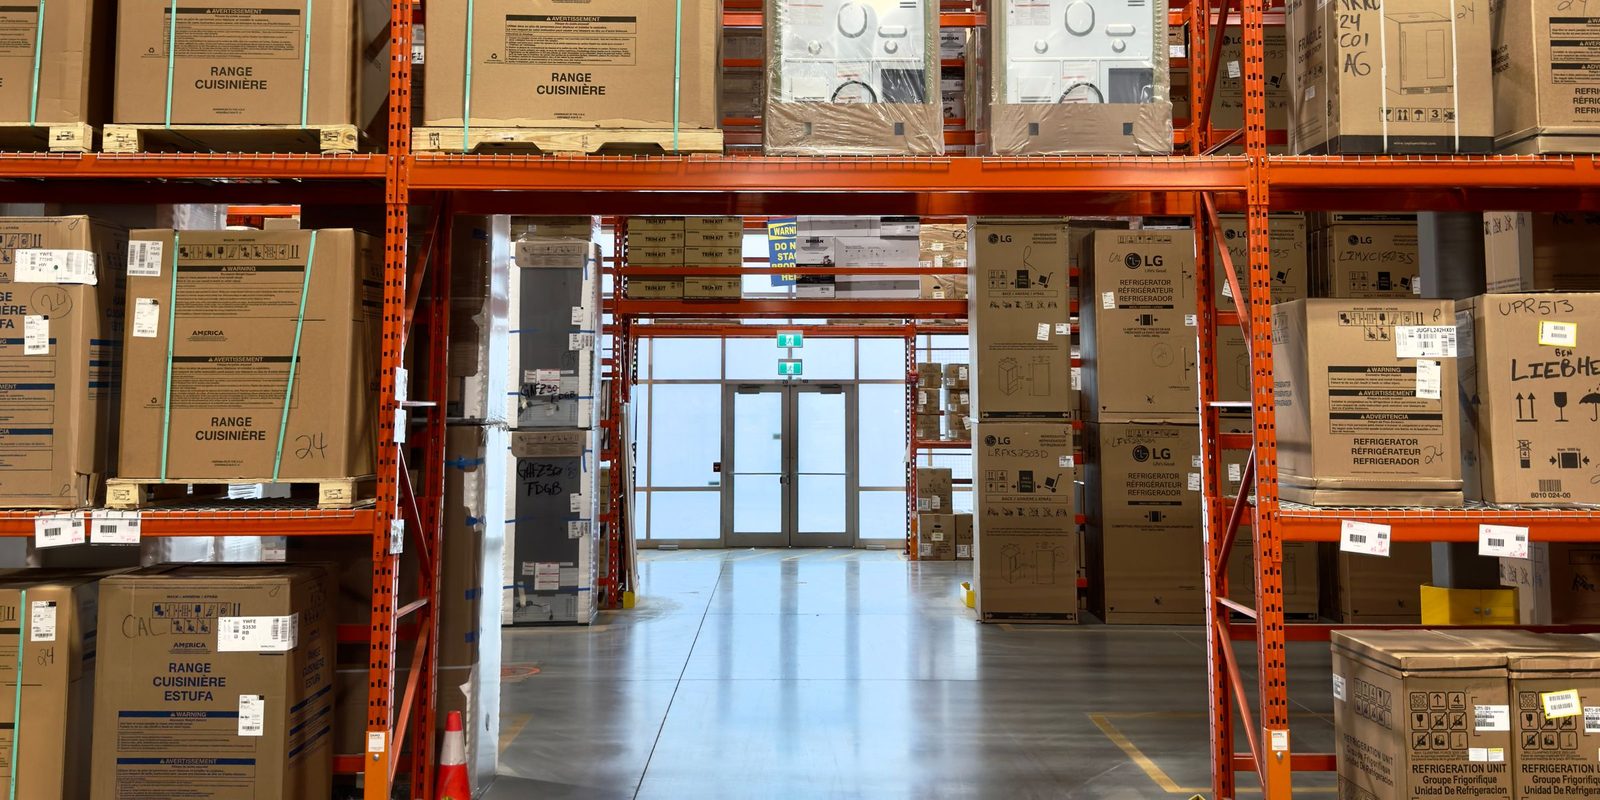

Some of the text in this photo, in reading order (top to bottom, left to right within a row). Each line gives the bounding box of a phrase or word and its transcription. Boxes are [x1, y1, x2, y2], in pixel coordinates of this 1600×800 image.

[1340, 14, 1361, 31] 24
[210, 66, 253, 77] RANGE
[551, 72, 592, 83] RANGE
[194, 78, 268, 90] CUISINIÈRE
[536, 84, 606, 96] CUISINIÈRE
[1431, 109, 1439, 119] 3
[1000, 234, 1012, 243] LG
[1360, 236, 1373, 245] LG
[774, 242, 787, 251] DO
[1144, 255, 1163, 267] LG
[210, 417, 252, 427] RANGE
[195, 428, 266, 441] CUISINIÈRE
[295, 432, 328, 459] 24
[997, 436, 1011, 445] LG
[1353, 438, 1418, 446] REFRIGERATOR
[1152, 447, 1171, 460] LG
[1351, 446, 1421, 456] RÉFRIGÉRATEUR
[121, 615, 167, 639] CAL
[168, 663, 211, 673] RANGE
[152, 675, 226, 687] CUISINIÈRE
[164, 691, 213, 701] ESTUFA
[1453, 694, 1460, 704] 4
[1412, 763, 1507, 774] REFRIGERATION UNIT
[1522, 764, 1594, 773] REFRIGERATION
[1422, 775, 1497, 786] Groupe Frigorifique
[1532, 775, 1560, 786] Groupe
[1415, 786, 1507, 796] Unidad De Refrigeracion
[1524, 786, 1550, 796] Unidad
[1554, 786, 1564, 795] De
